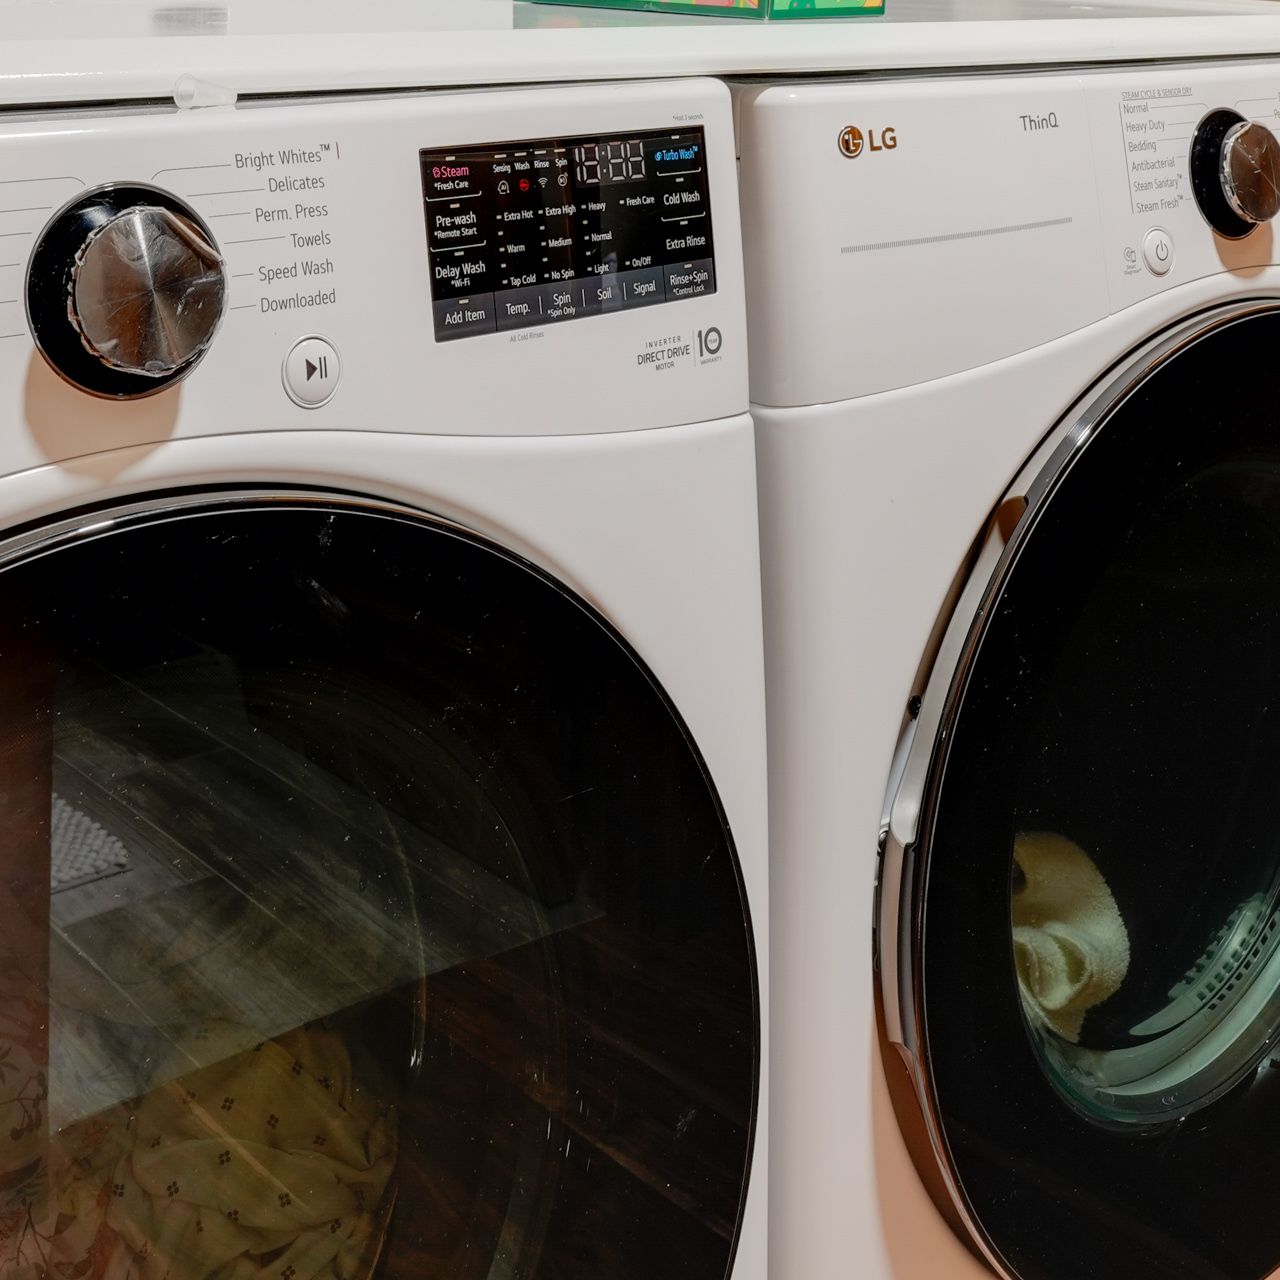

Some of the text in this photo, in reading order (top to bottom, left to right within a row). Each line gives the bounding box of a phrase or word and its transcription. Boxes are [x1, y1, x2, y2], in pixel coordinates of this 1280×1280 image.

[1121, 91, 1140, 100] STEAM
[1140, 89, 1156, 98] CYCLE
[1123, 101, 1149, 114] Normal
[1019, 112, 1059, 131] ThinQ
[1125, 119, 1165, 134] Heavy Duty
[868, 127, 898, 152] LG
[1128, 140, 1157, 153] Bedding
[234, 151, 276, 171] Bright
[662, 149, 679, 161] Turbo
[493, 163, 511, 173] Sensing
[514, 161, 530, 171] Wash
[534, 160, 550, 169] Rinse
[555, 158, 568, 167] Spin
[1131, 156, 1175, 172] Antibacterial
[441, 166, 469, 178] Steam
[268, 176, 325, 193] Delicates
[454, 180, 469, 189] Care
[1133, 180, 1153, 193] Steam
[626, 195, 655, 206] Fresh Care
[663, 190, 701, 206] Cold Wash
[545, 204, 577, 217] Extra High
[588, 201, 606, 212] Heavy
[1136, 202, 1160, 214] Steam
[255, 204, 329, 223] Perm. Press
[436, 211, 477, 227] Pre-wash
[504, 210, 534, 221] Extra Hot
[461, 227, 477, 237] Start
[591, 231, 612, 242] Normal
[290, 230, 332, 248] Towels
[548, 237, 573, 248] Medium
[666, 235, 706, 250] Extra Rinse
[507, 244, 526, 253] Warm
[632, 256, 652, 267] On/Off
[258, 258, 334, 285] Speed Wash
[435, 260, 486, 279] Delay Wash
[551, 268, 575, 280] No Spin
[594, 263, 609, 275] Light
[510, 274, 537, 287] Tap Cold
[670, 270, 708, 286] Rinse+Spin
[597, 287, 613, 301] Soil
[633, 280, 656, 296] Signal
[693, 284, 705, 293] Lock
[260, 288, 336, 313] Downloaded
[553, 292, 572, 308] Spin
[506, 303, 531, 316] Temp.
[563, 306, 576, 316] Only
[445, 310, 486, 326] Add Item
[645, 336, 681, 348] INVERTER
[697, 326, 723, 357] 10
[637, 345, 690, 365] DIRECT DRIVE
[655, 361, 675, 371] MOTOR
